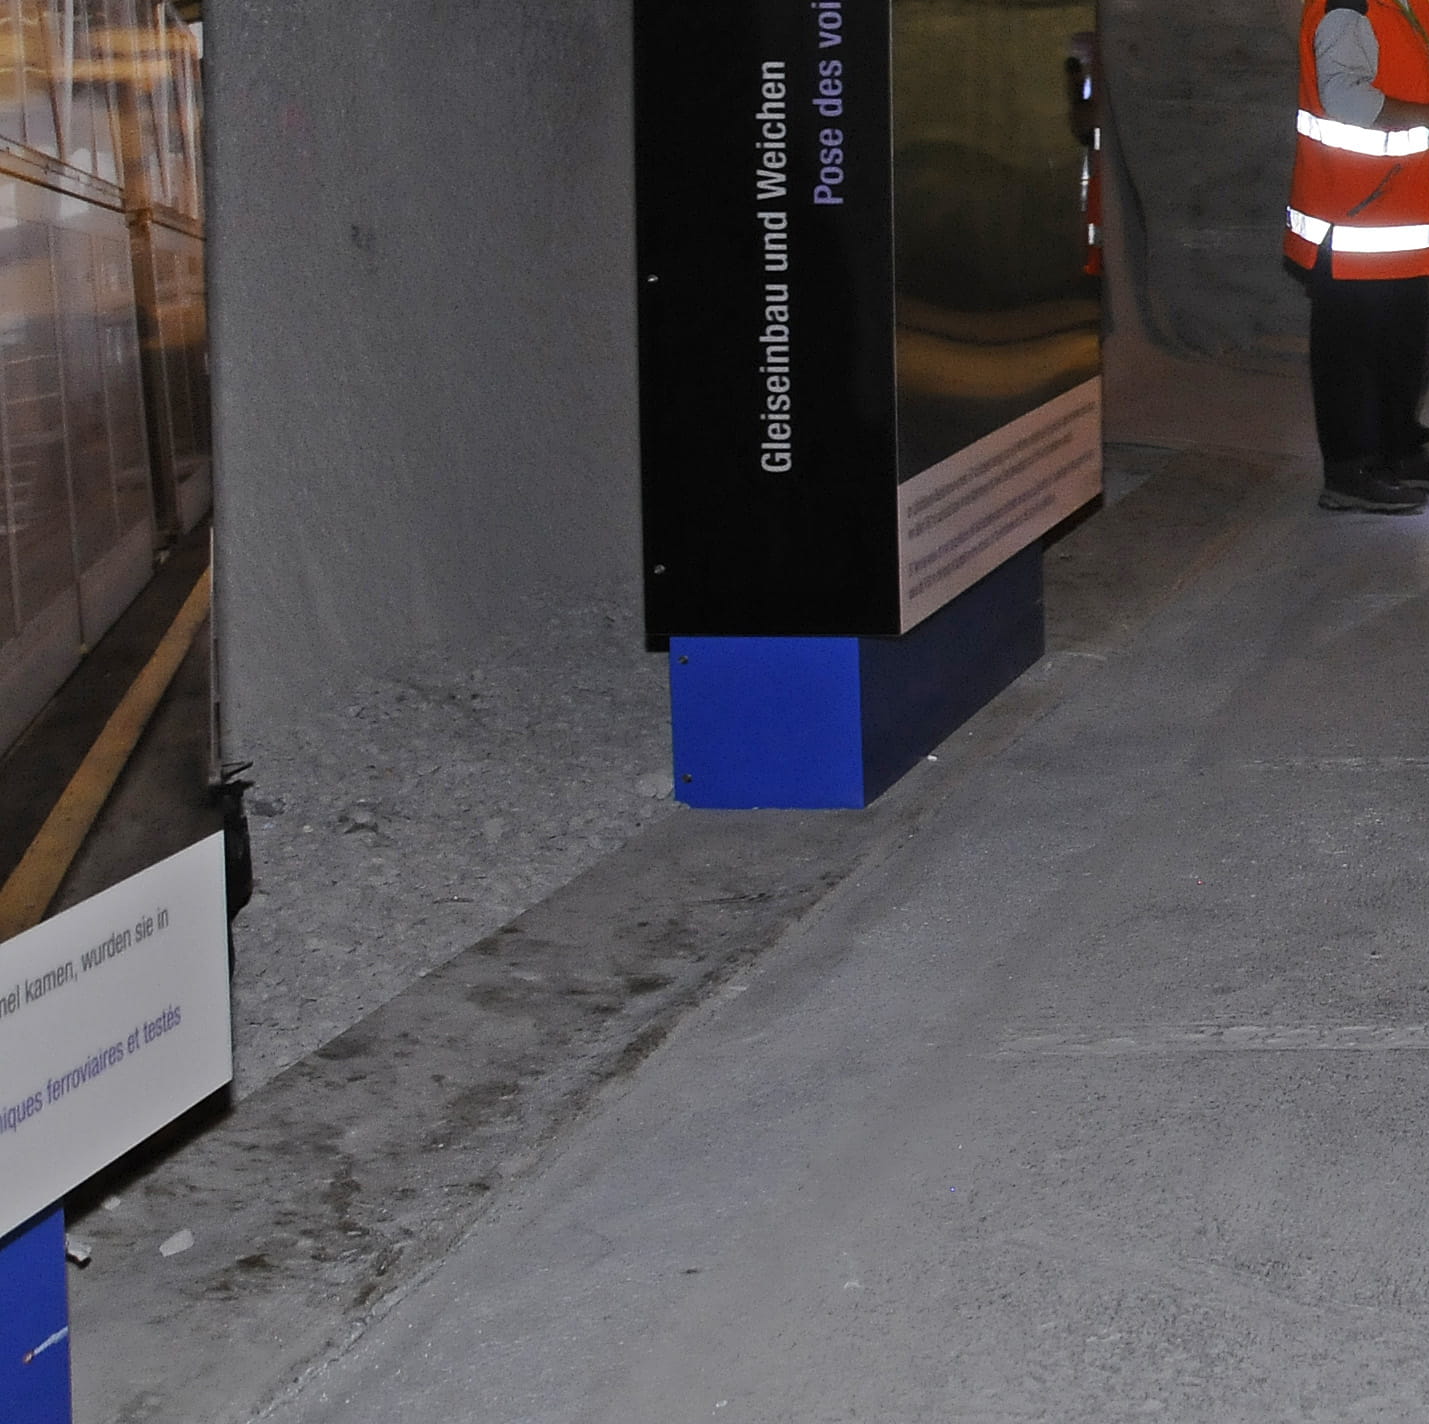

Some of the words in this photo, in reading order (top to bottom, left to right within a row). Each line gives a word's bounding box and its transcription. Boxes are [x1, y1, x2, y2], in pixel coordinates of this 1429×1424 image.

[755, 61, 787, 200] Weichen
[812, 59, 843, 117] des
[813, 128, 844, 205] Pose
[756, 211, 789, 272] und
[759, 284, 792, 473] Gleiseinbau
[24, 960, 78, 1006] kamen,
[80, 926, 132, 973] wurden
[134, 914, 153, 944] sie
[157, 907, 169, 932] in
[46, 1040, 124, 1106] ferroviaires
[127, 1026, 140, 1055] et
[142, 1003, 182, 1044] testés
